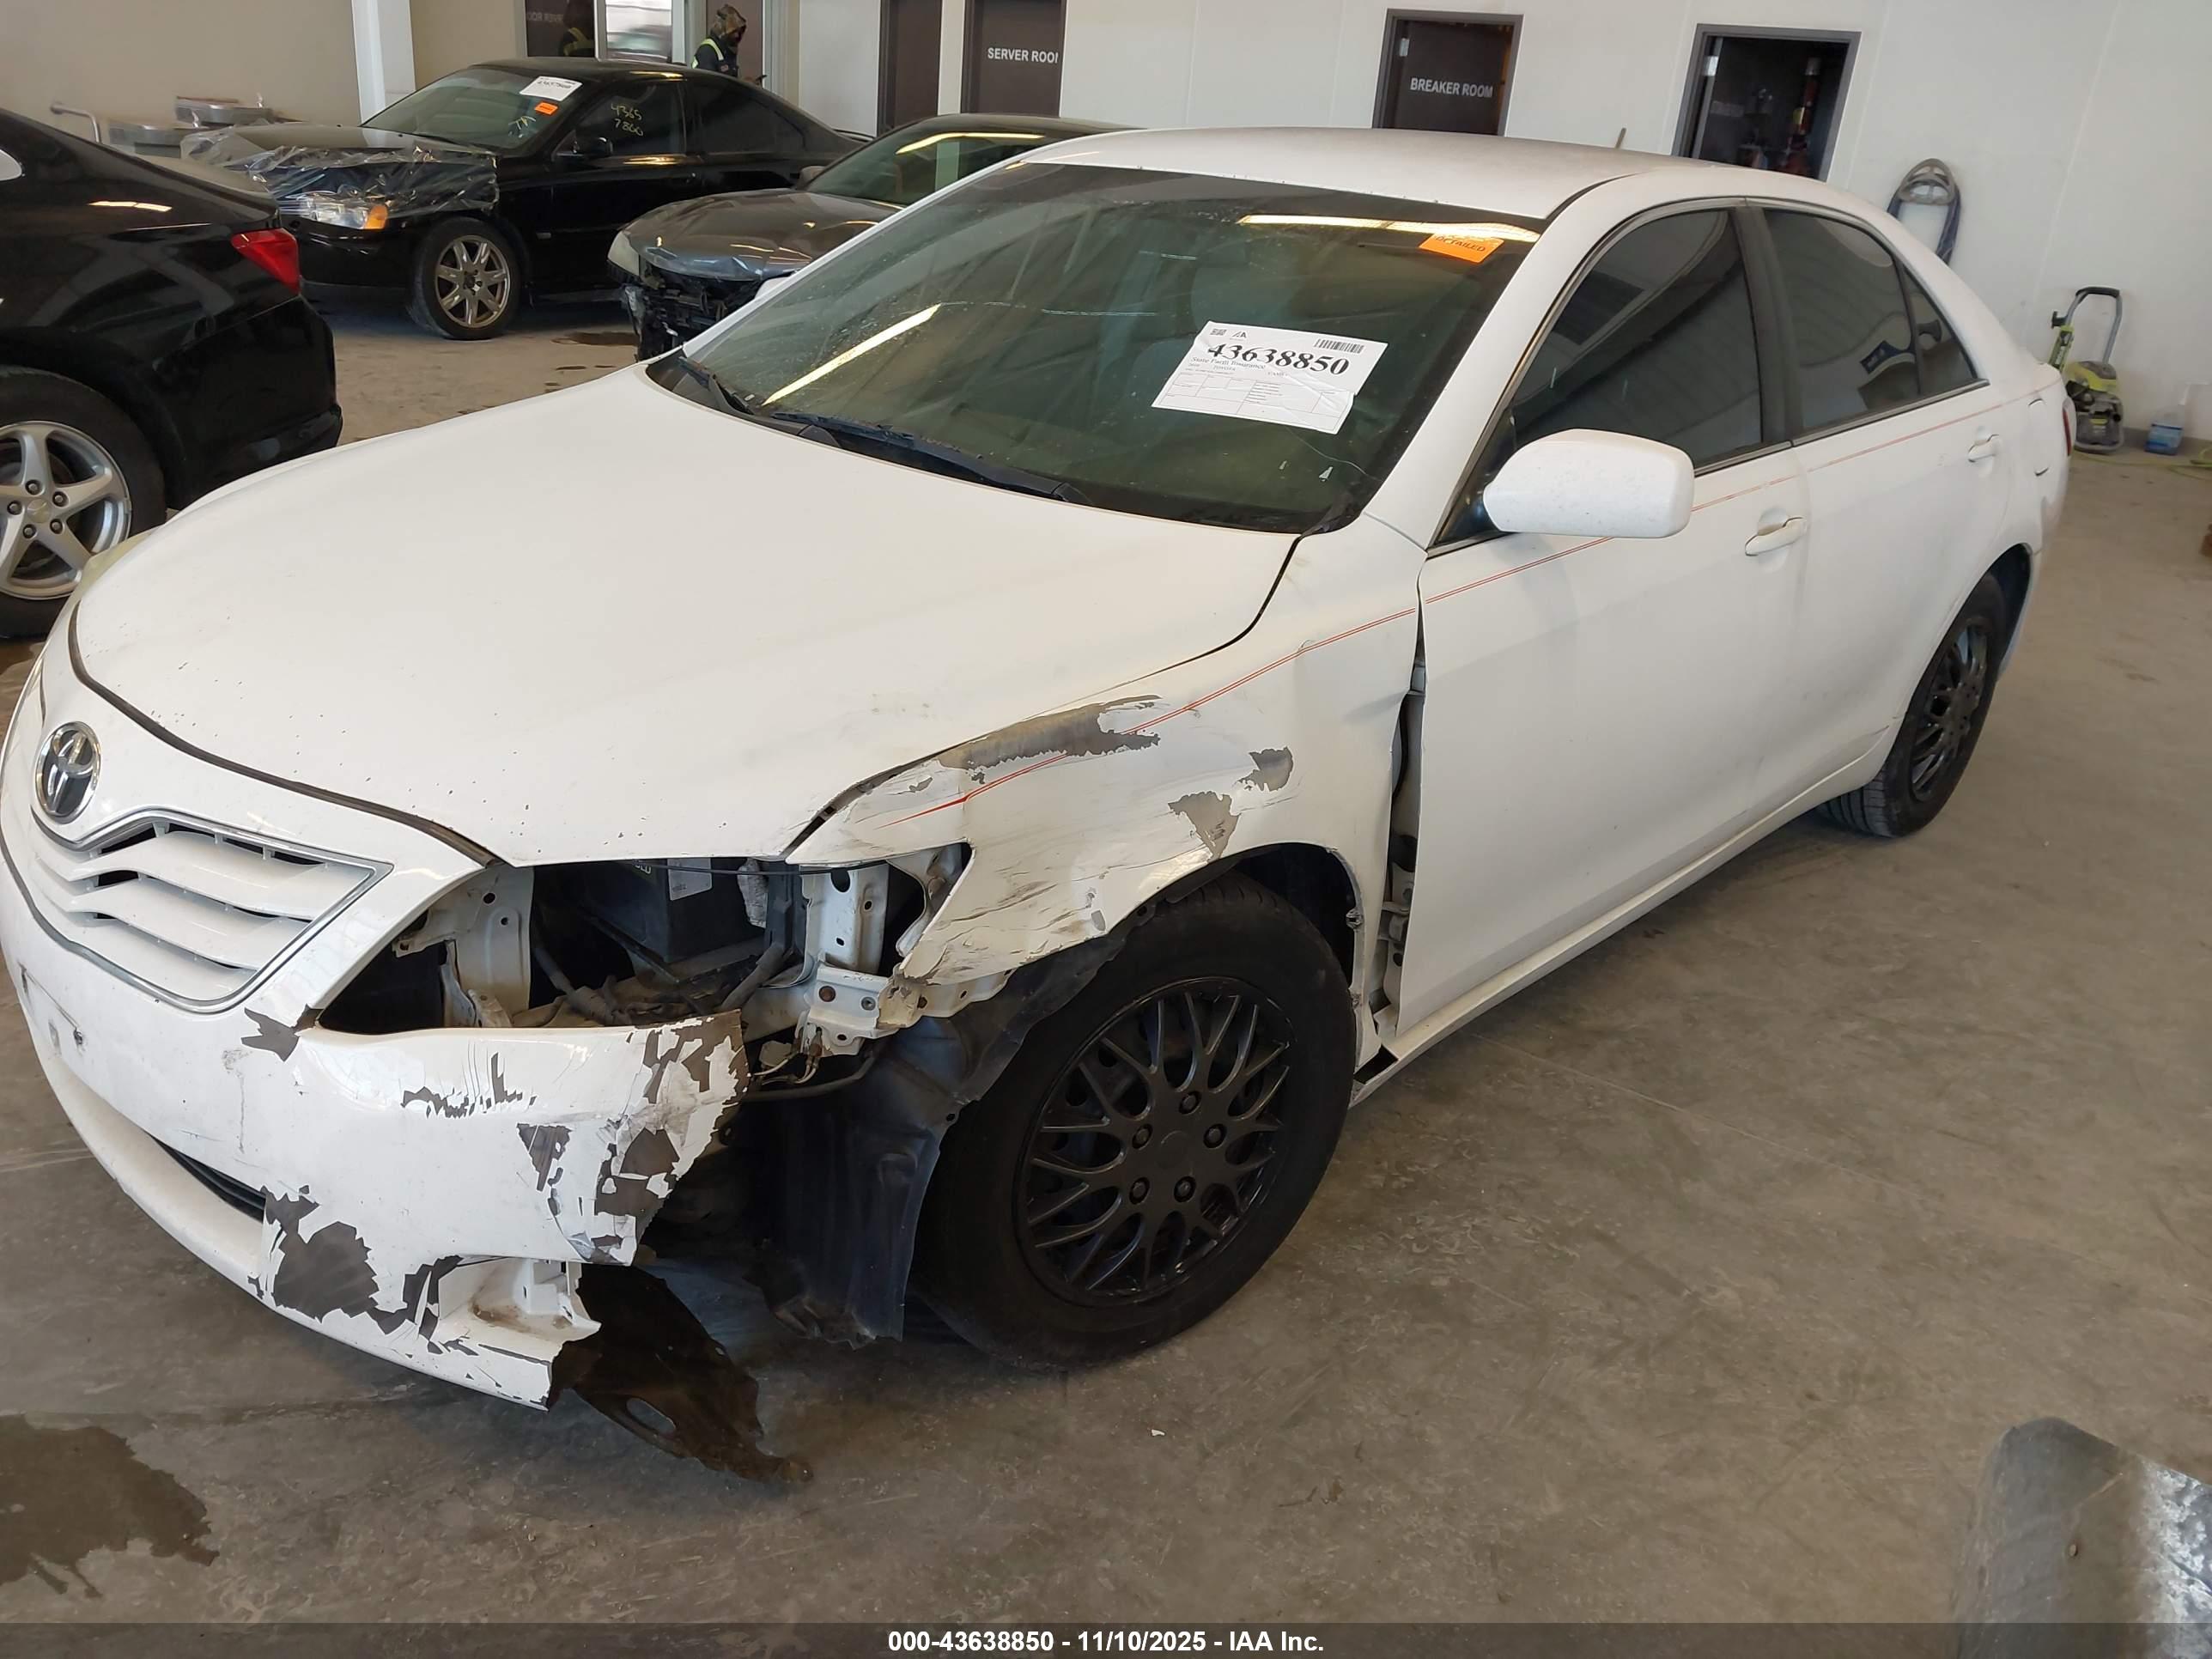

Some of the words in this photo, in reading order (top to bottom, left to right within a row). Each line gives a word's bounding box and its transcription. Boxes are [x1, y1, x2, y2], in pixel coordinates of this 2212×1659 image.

[988, 47, 1029, 62] SERVER
[1410, 77, 1460, 96] BREAKER
[1462, 83, 1493, 98] ROOM
[1207, 343, 1350, 375] 43638850
